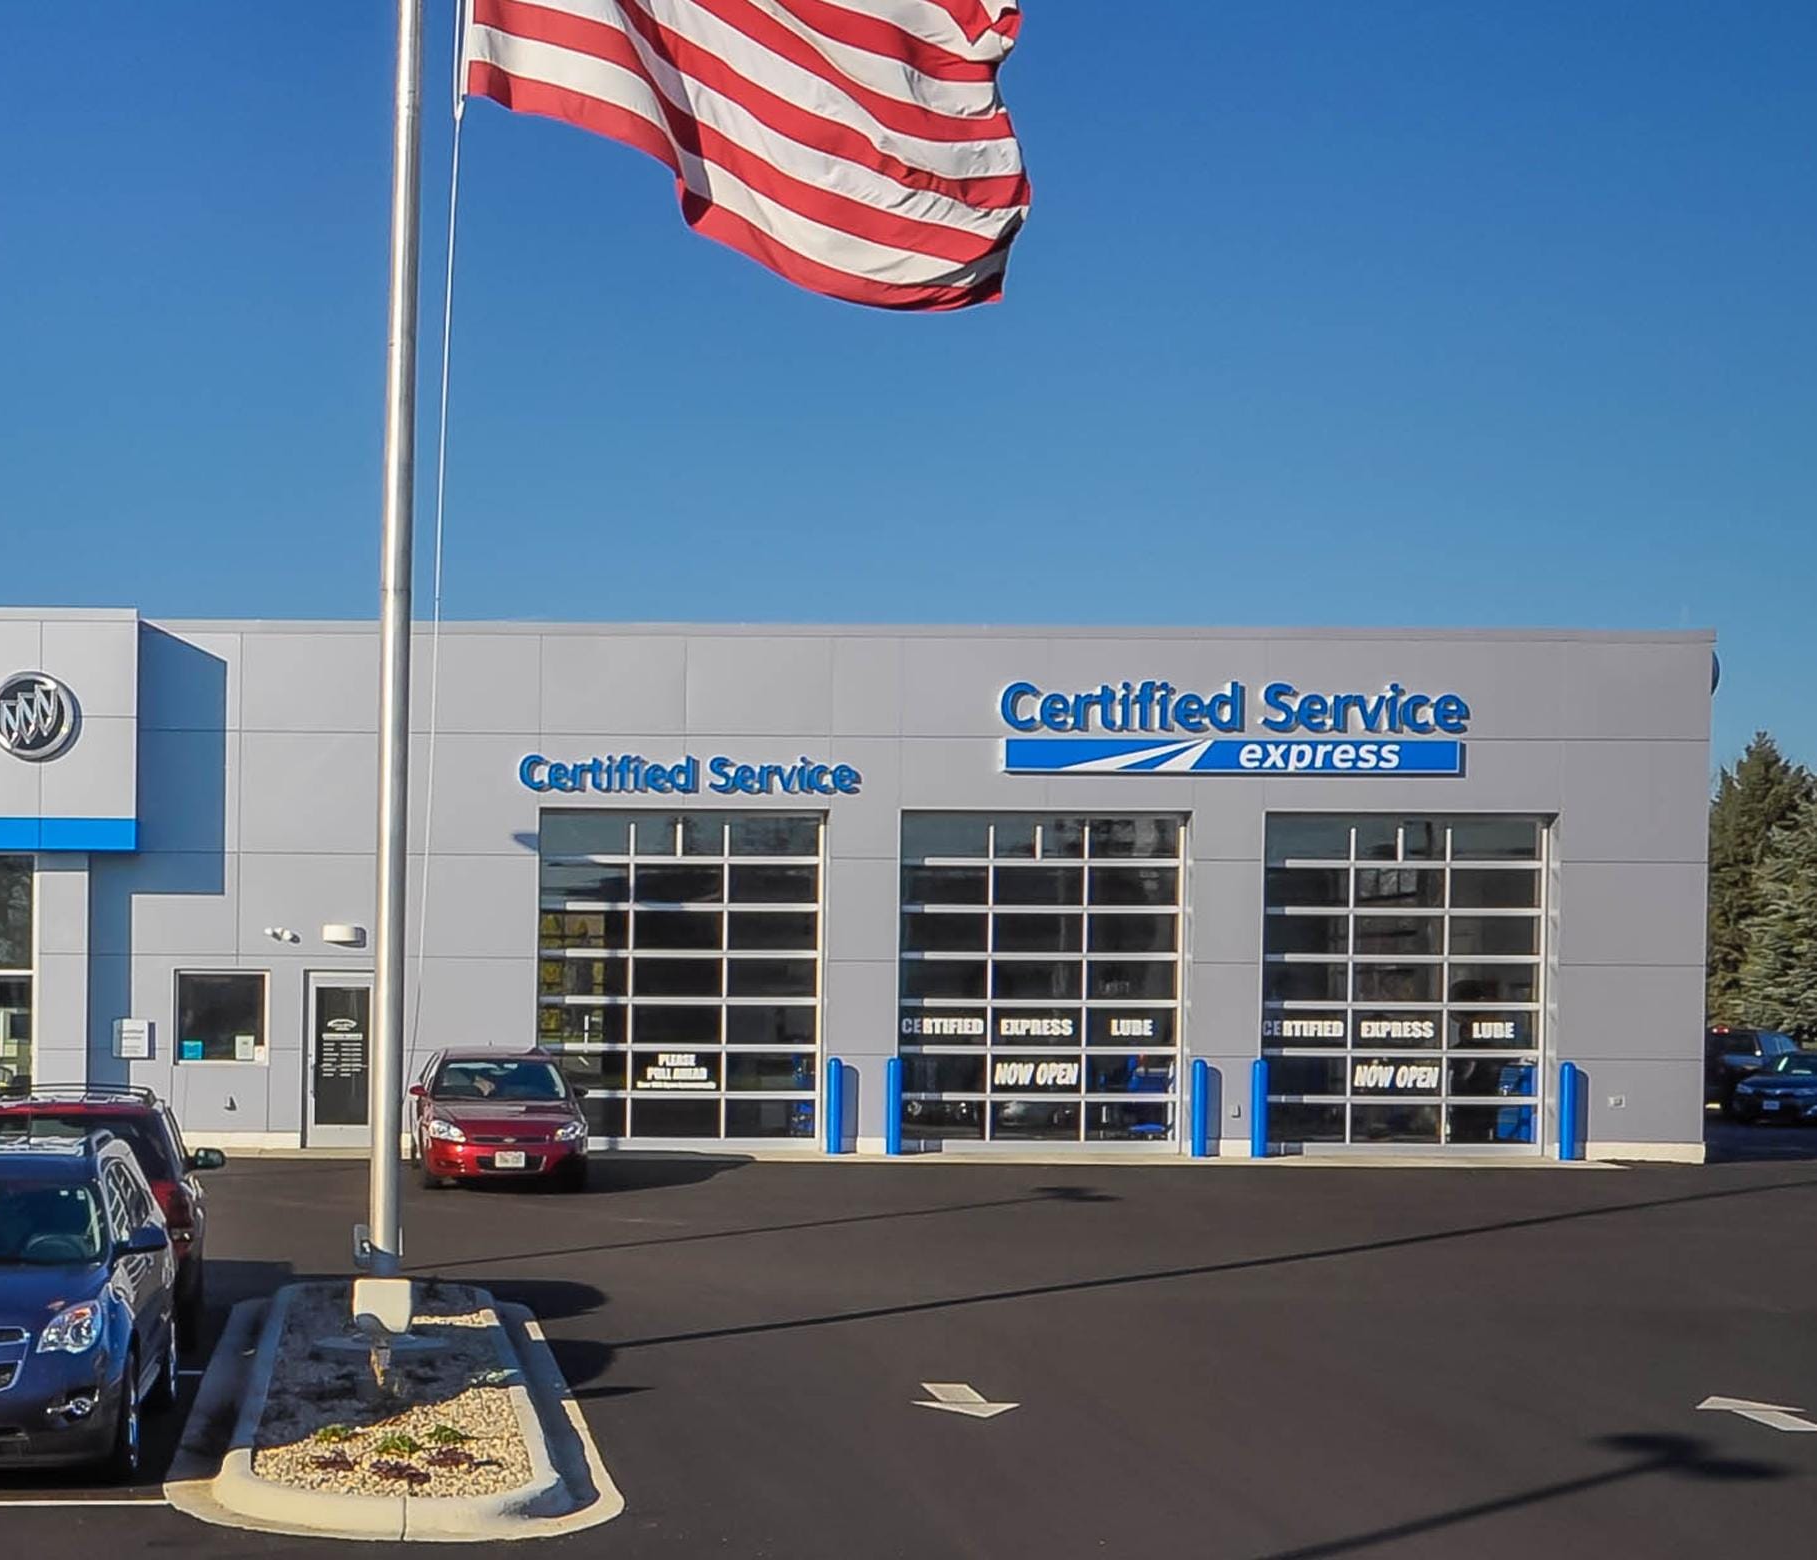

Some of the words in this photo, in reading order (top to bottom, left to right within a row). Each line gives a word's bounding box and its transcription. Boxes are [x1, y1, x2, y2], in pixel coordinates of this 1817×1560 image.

[1000, 681, 1245, 733] Certified
[1263, 682, 1470, 733] Service
[1238, 741, 1400, 770] express
[519, 754, 700, 794] Certified
[709, 756, 862, 795] Service
[901, 1017, 984, 1036] CERTIFIED
[1000, 1018, 1073, 1036] EXPRESS
[1111, 1019, 1154, 1037] LUBE
[1262, 1020, 1344, 1038] CERTIFIED
[1360, 1021, 1434, 1038] EXPRESS
[1472, 1021, 1515, 1039] LUBE
[994, 1062, 1033, 1086] NOW
[1036, 1062, 1079, 1086] OPEN
[1354, 1065, 1393, 1088] NOW
[1396, 1065, 1440, 1088] OPEN
